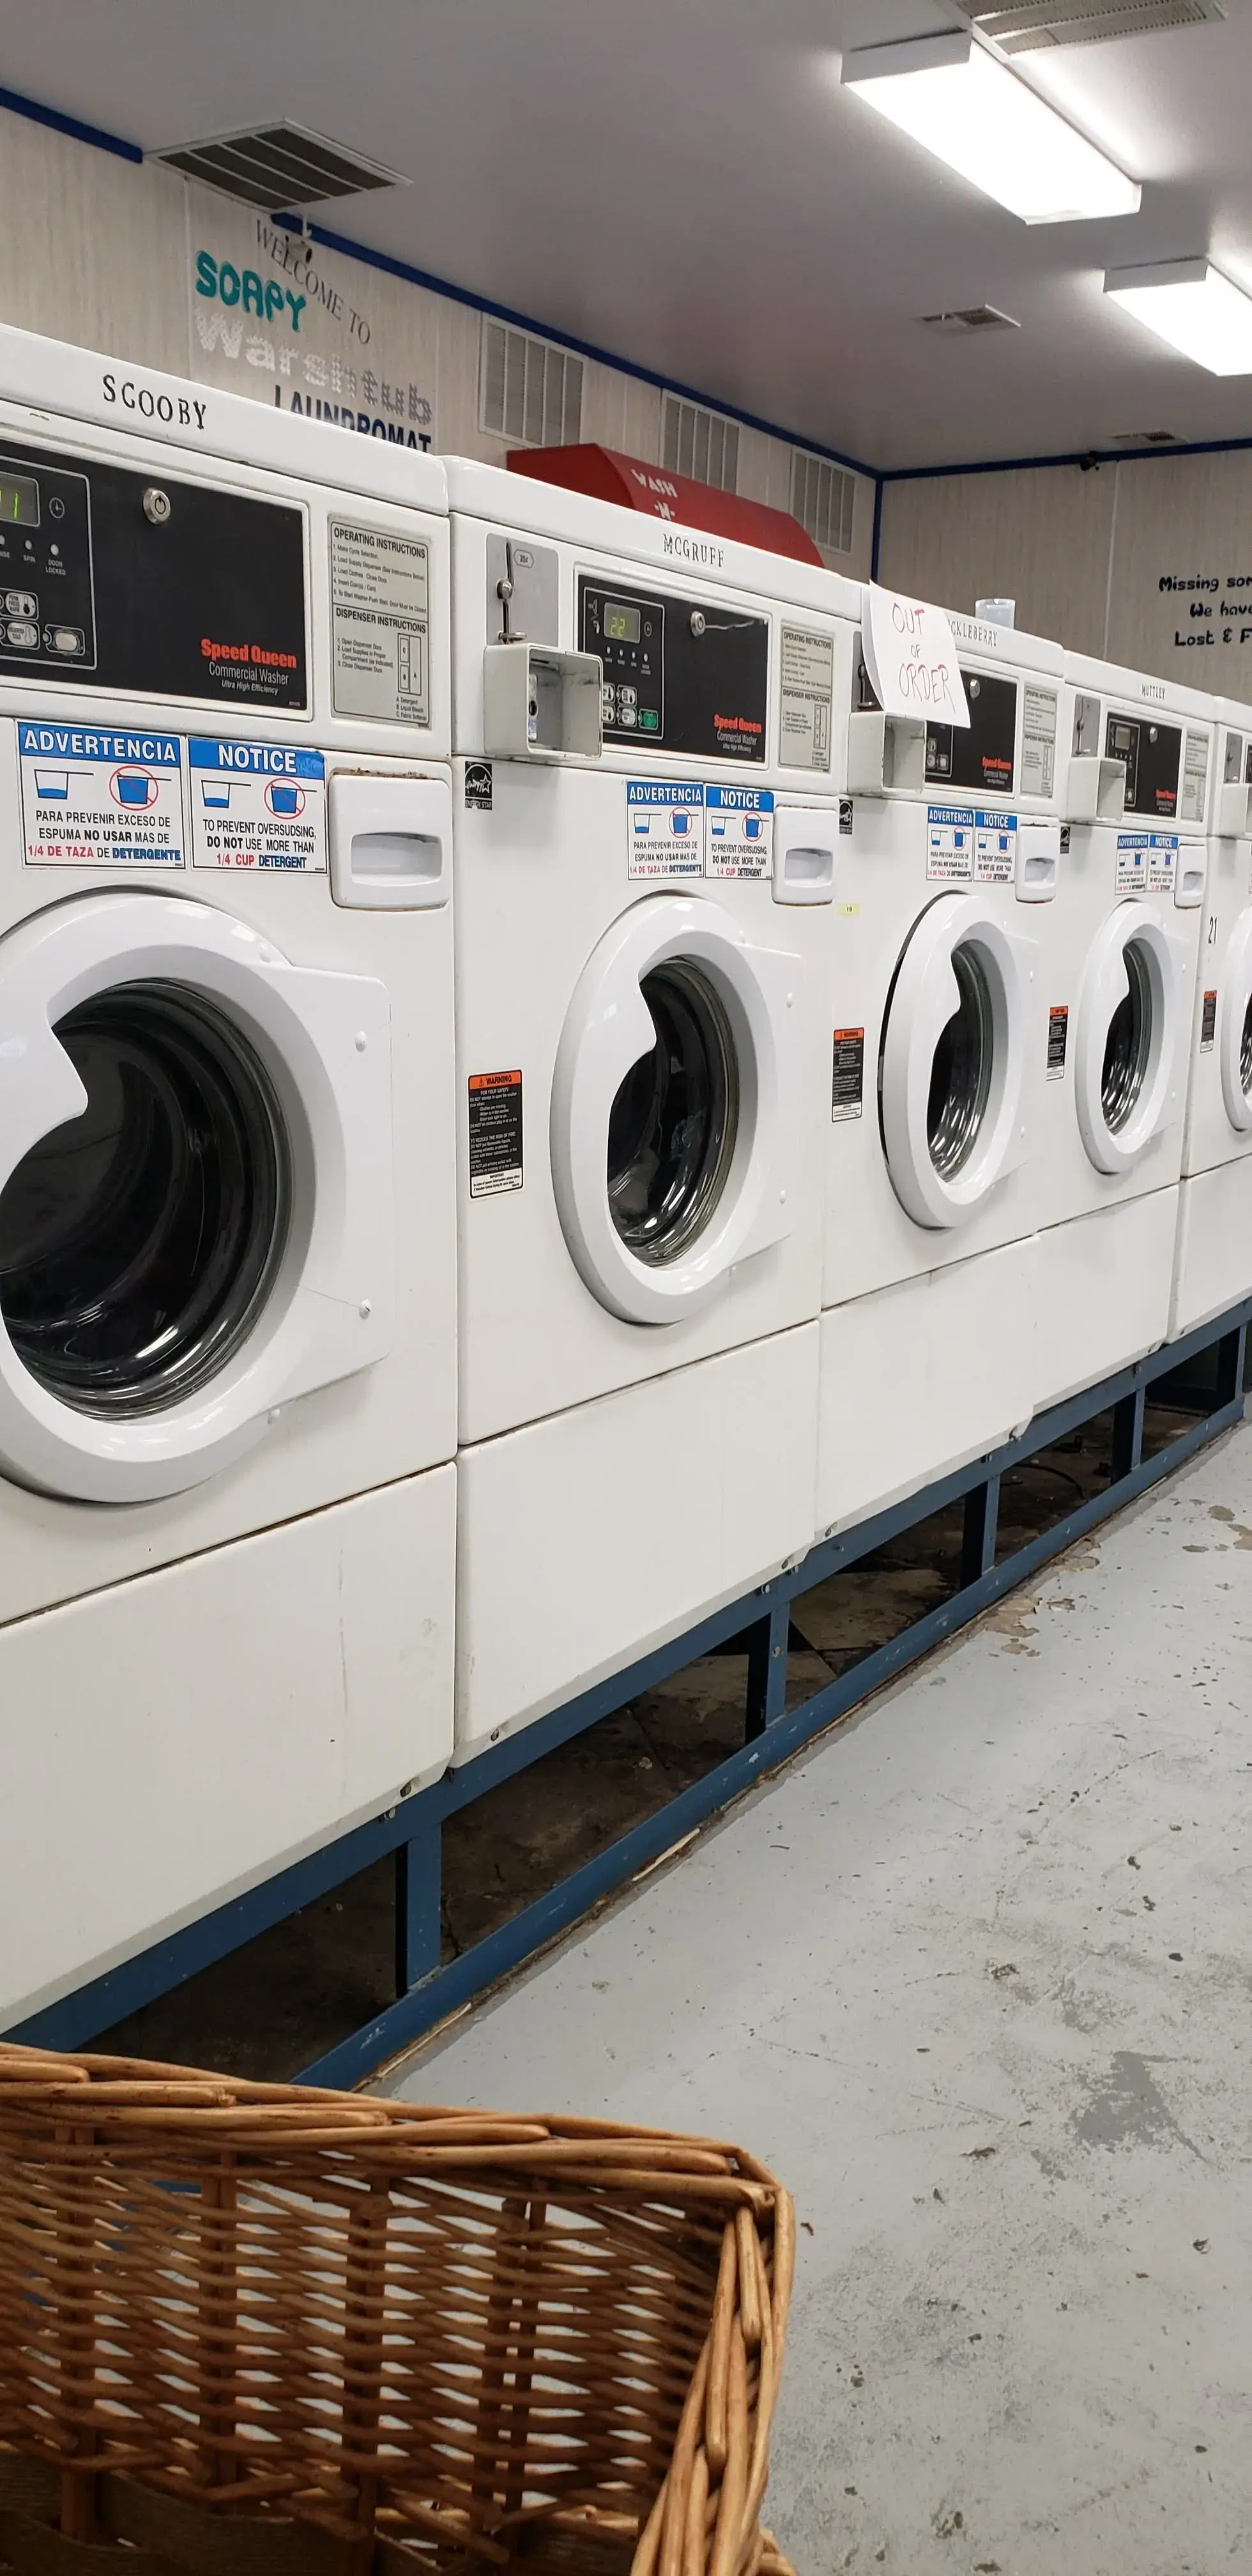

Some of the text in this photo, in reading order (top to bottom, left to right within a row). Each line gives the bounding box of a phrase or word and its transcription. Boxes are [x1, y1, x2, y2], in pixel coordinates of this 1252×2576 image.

[256, 219, 370, 344] WELCOME TO
[195, 250, 306, 332] SOAPY
[103, 374, 206, 429] SCOOBY
[334, 527, 425, 558] OPERATING INSTRUCTIONS
[663, 533, 724, 567] MCGRUFF
[1159, 574, 1219, 593] Missing
[892, 602, 925, 635] OUT
[1189, 602, 1212, 618] We
[337, 608, 425, 633] DISPENSER INSTRUCTIONS
[611, 617, 625, 636] 22
[784, 631, 831, 650] OPERATING INSTRUCTIONS
[948, 618, 997, 647] CKLEBERRY
[1175, 629, 1214, 647] Lost
[1223, 627, 1232, 643] &
[201, 638, 297, 668] Speed Queen
[911, 644, 921, 658] OF
[209, 661, 289, 685] Commercial Washer
[222, 680, 279, 696] Ultra High Efficiency
[899, 663, 956, 714] ORDER
[714, 714, 761, 733] Speed Queen
[24, 730, 176, 762] ADVERTENCIA
[218, 744, 297, 772] NOTICE
[629, 786, 701, 802] ADVERTENCIA
[721, 790, 760, 808] NOTICE
[36, 810, 171, 827] PARA PREVENIR EXCESO DE
[929, 810, 972, 824] ADVERTENCIA
[984, 814, 1009, 828] NOTICE
[38, 827, 169, 843] ESPUMA NO USAR MAS DE
[203, 819, 316, 839] TO PREVENT OVERSUDSING,
[207, 836, 314, 853] DO NOT USE MORE THAN
[634, 841, 646, 850] PARA
[648, 841, 671, 850] PREVENIR
[711, 843, 717, 852] TO
[718, 844, 737, 853] PREVENT
[1156, 837, 1172, 848] NOTICE
[28, 845, 181, 861] 1/4 DE TAZA DE DETERGENTE
[217, 853, 307, 869] 1/4 CUP DETERGENT
[635, 854, 655, 862] ESPUMA
[713, 855, 719, 864] DO
[721, 855, 730, 864] NOT
[731, 856, 740, 864] USE
[742, 857, 753, 865] MORE
[669, 864, 701, 873] DETERGENTE
[737, 868, 762, 877] DETERGENT
[1209, 916, 1218, 944] 21
[486, 1075, 512, 1085] WARNING
